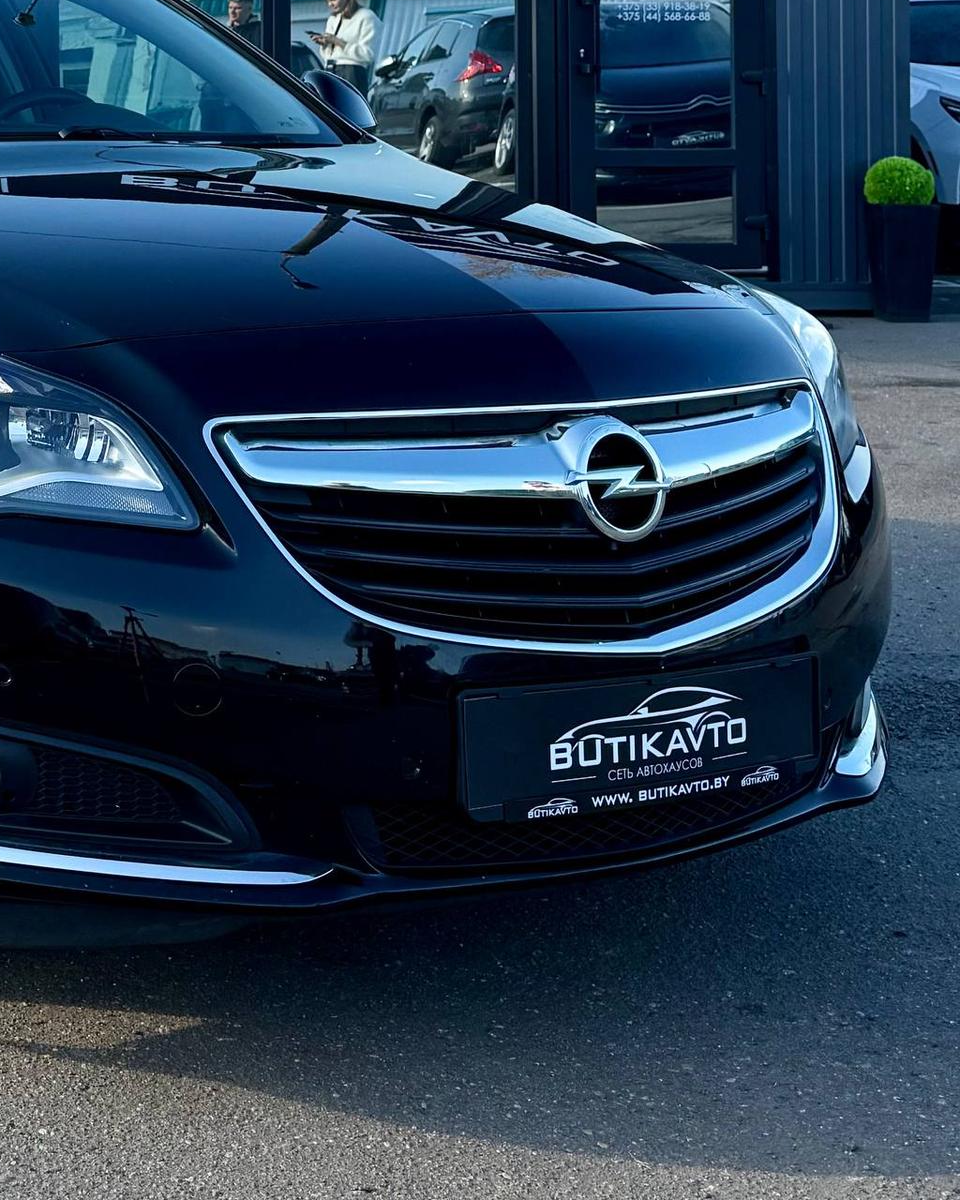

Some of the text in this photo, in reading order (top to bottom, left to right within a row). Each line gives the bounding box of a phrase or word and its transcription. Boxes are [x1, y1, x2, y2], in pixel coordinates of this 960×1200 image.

[616, 11, 711, 22] +375 (44) 568-66-88
[550, 717, 747, 770] BUTIKAVTO
[607, 757, 703, 781] СЕТЬ АВТОХАУСОВ
[638, 776, 730, 801] BUTIKAVTO.BY
[741, 772, 779, 787] BUTIKAVTO
[527, 805, 578, 819] BUTIKAVTO
